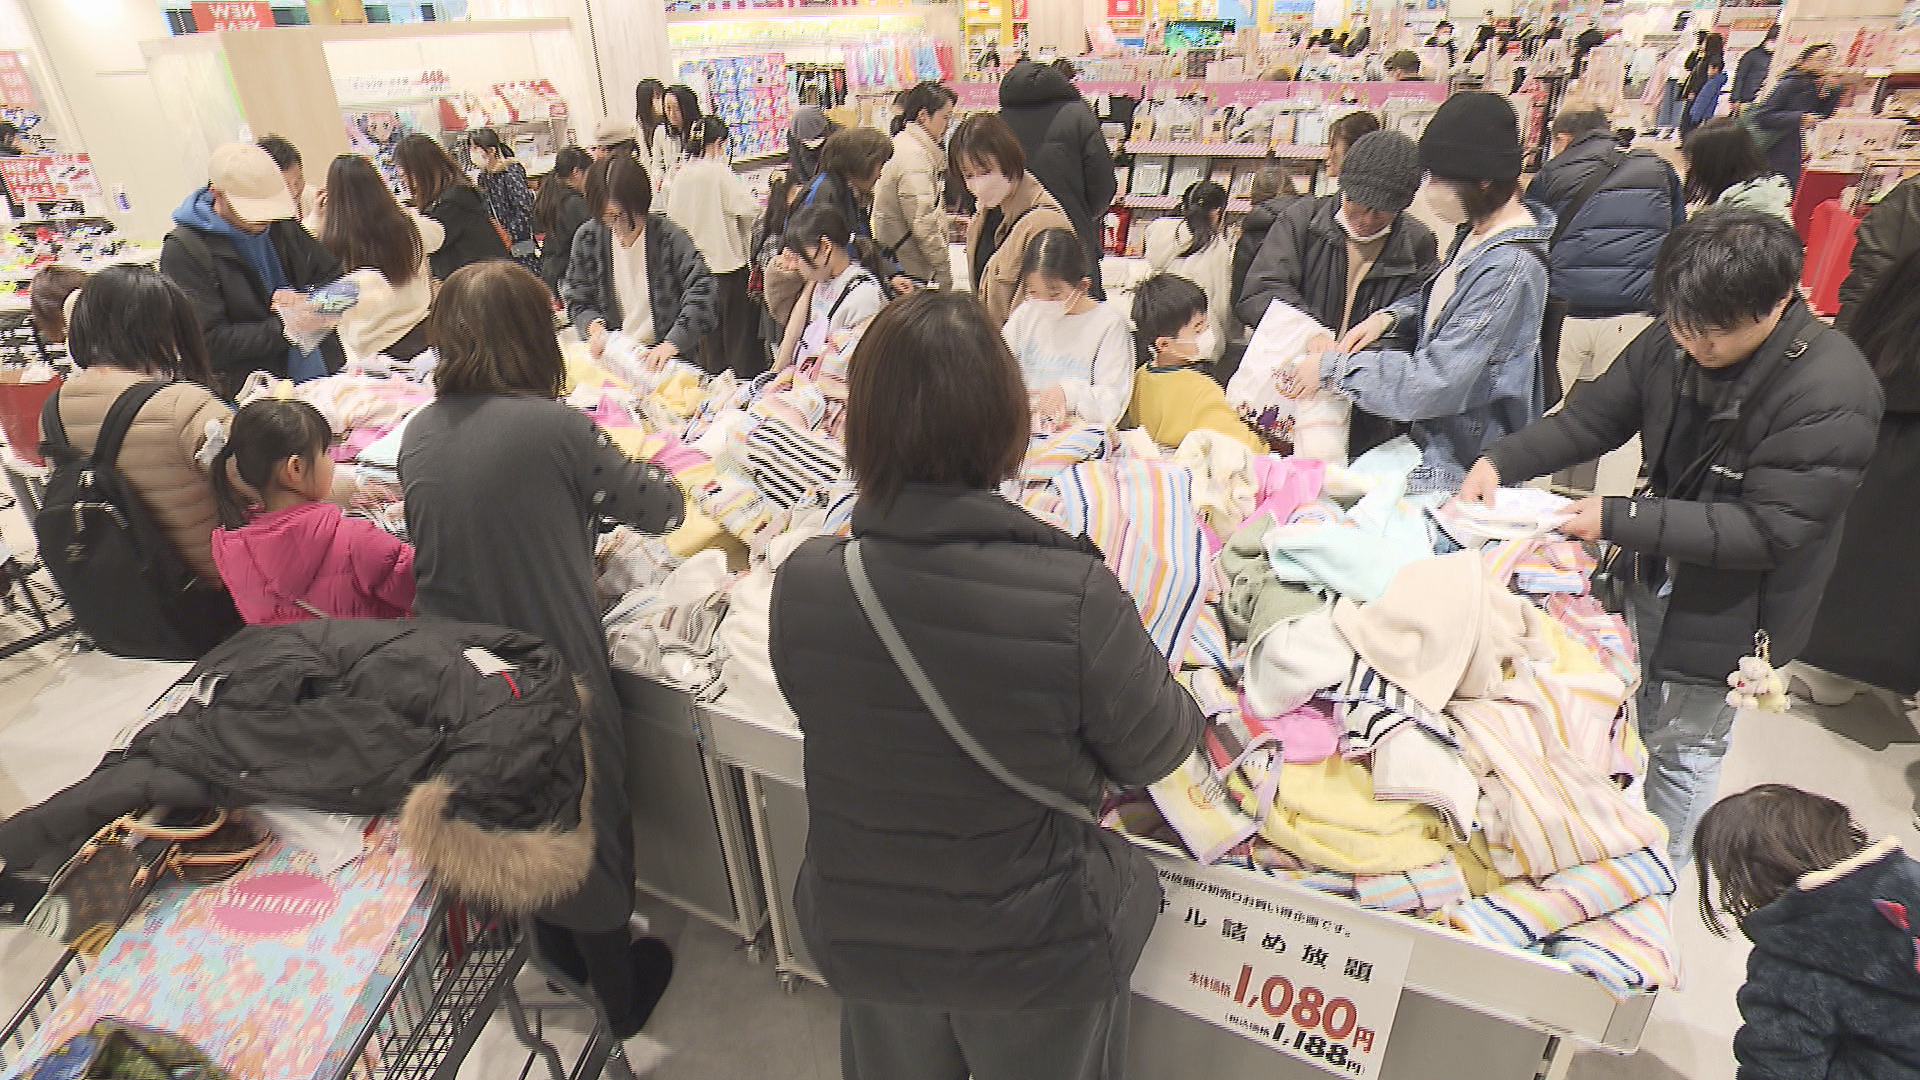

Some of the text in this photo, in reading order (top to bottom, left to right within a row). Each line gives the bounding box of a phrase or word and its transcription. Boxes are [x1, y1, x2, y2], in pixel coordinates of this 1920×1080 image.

[3, 160, 42, 175] NEW
[7, 173, 49, 188] YEAR
[14, 186, 53, 201] SALE
[214, 886, 332, 919] SWIMMER
[1188, 963, 1377, 1053] 本体価格 1,080円
